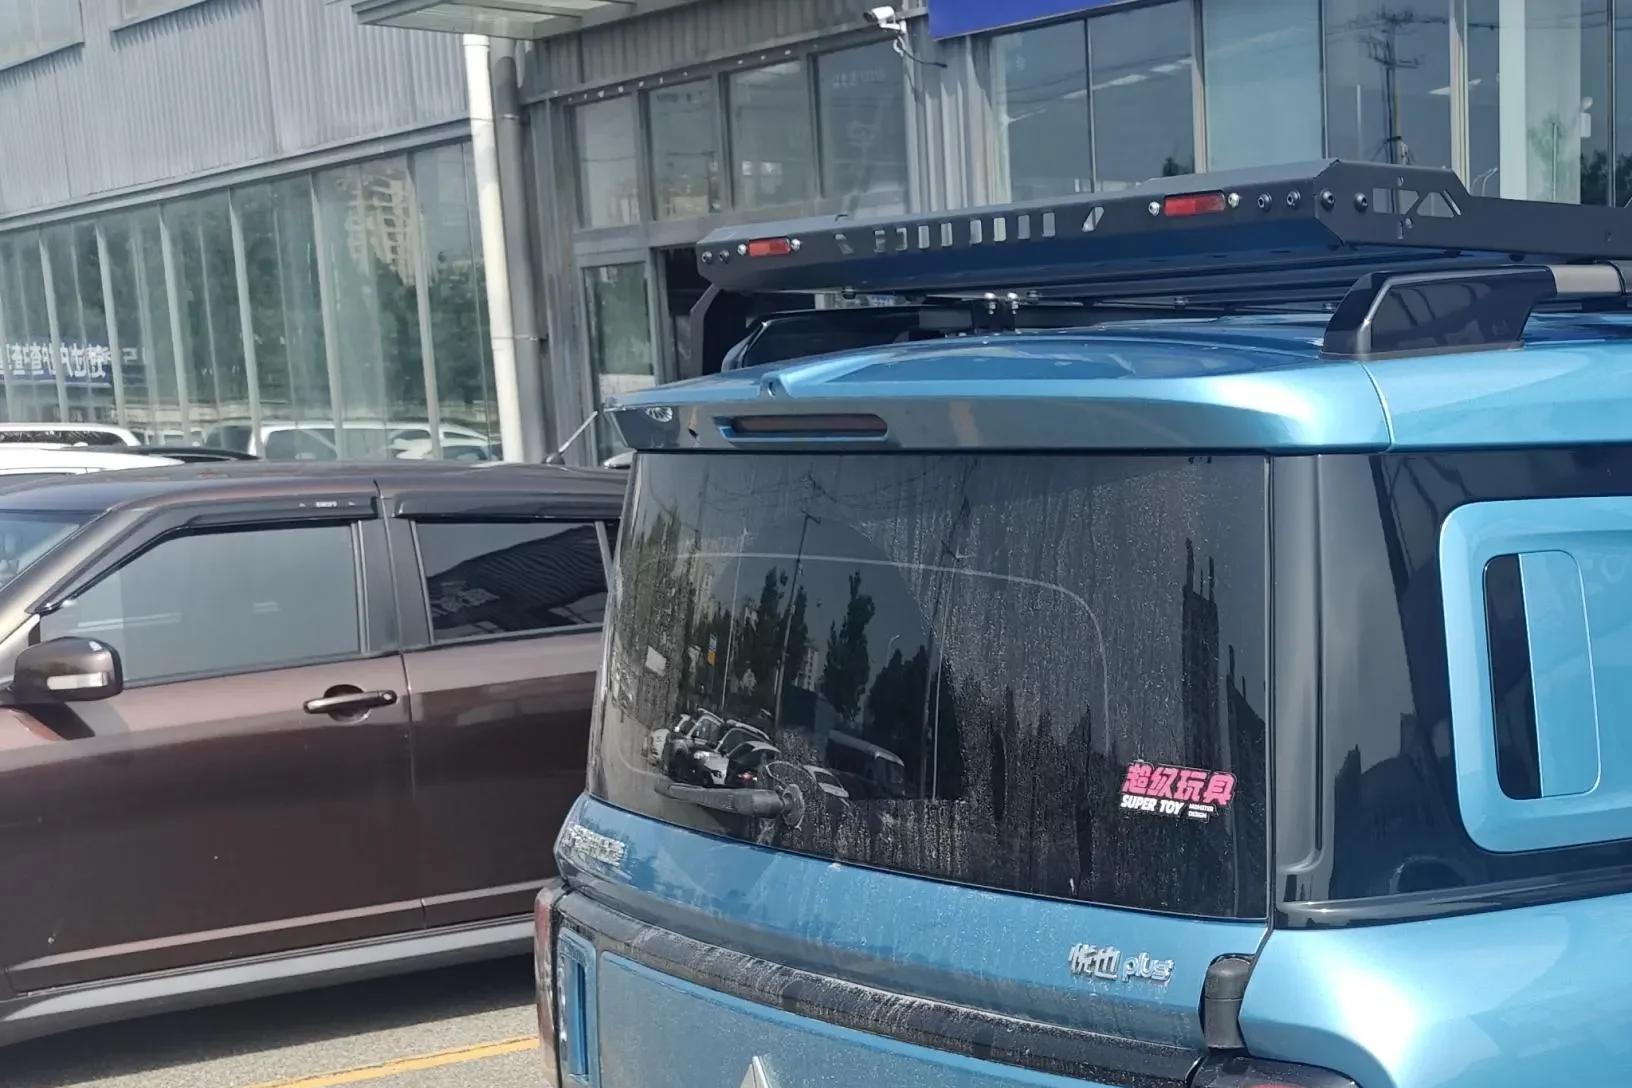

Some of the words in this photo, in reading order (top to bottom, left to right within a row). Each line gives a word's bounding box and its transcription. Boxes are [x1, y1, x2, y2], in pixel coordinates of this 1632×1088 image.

[1121, 763, 1235, 806] 超级玩具
[1121, 795, 1157, 812] SUPER
[1159, 799, 1185, 815] TOY
[1068, 943, 1120, 980] 悦也
[1122, 952, 1175, 982] plus
